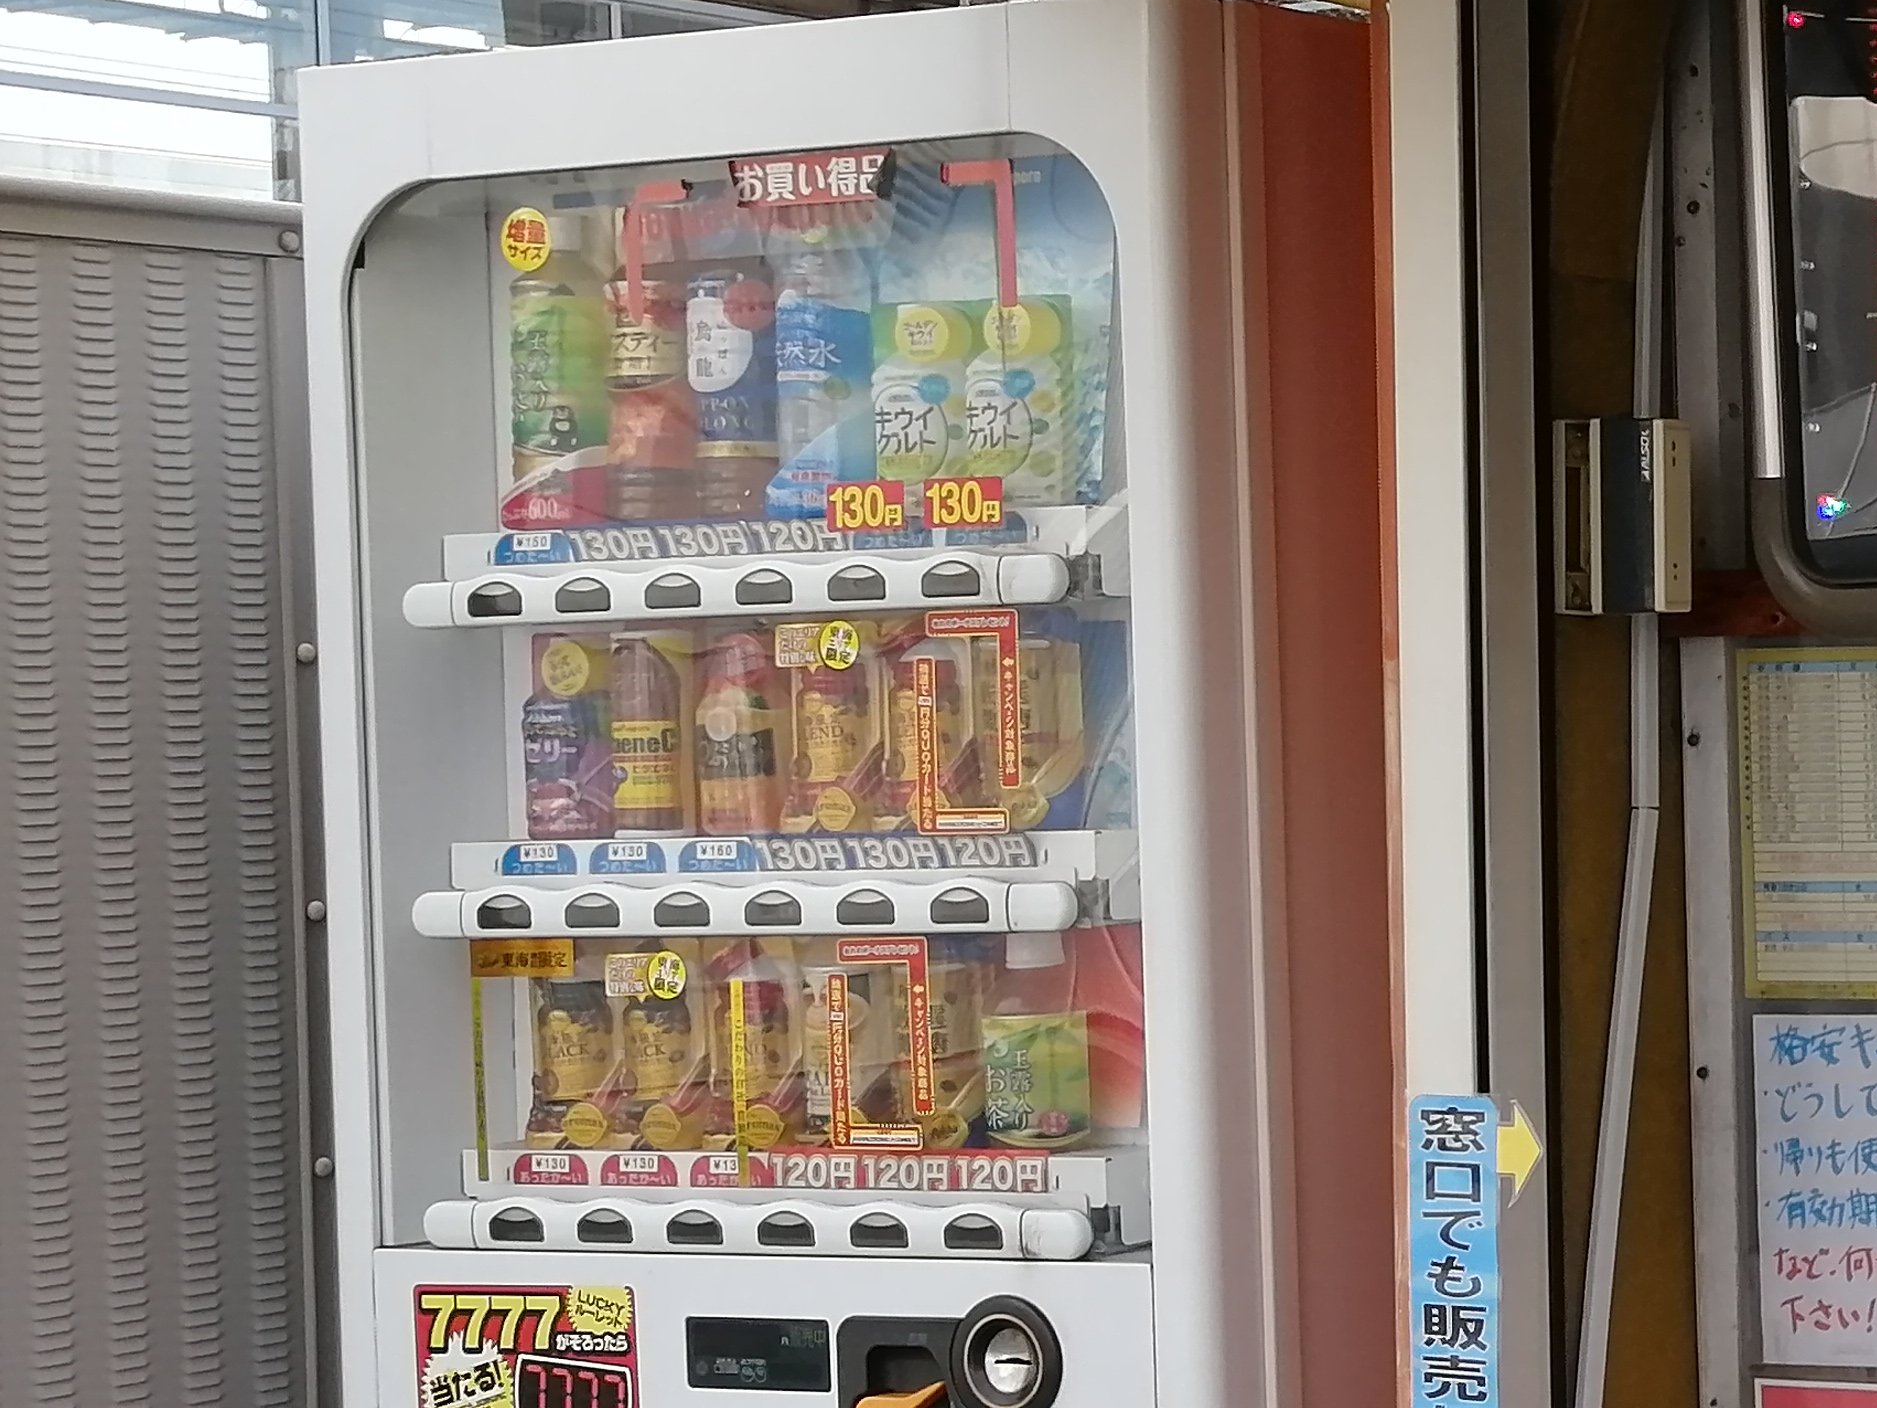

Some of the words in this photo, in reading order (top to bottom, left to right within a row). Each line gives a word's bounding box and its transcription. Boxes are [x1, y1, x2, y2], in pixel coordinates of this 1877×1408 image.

[507, 220, 546, 245] 増量
[830, 487, 902, 528] 130円
[926, 482, 1001, 524] 130円
[574, 529, 657, 559] 130円
[661, 527, 749, 557] 130円
[759, 838, 846, 868] 130円
[850, 838, 939, 867] 130円
[942, 838, 1030, 867] 120円
[535, 1157, 567, 1169] ¥130
[772, 1157, 855, 1188] 120円
[863, 1158, 948, 1189] 120円
[957, 1158, 1044, 1189] 120円
[577, 1289, 625, 1315] LUCKY
[420, 1294, 561, 1350] 7777
[556, 1335, 628, 1352] がそろったら
[430, 1360, 504, 1408] 当たる!
